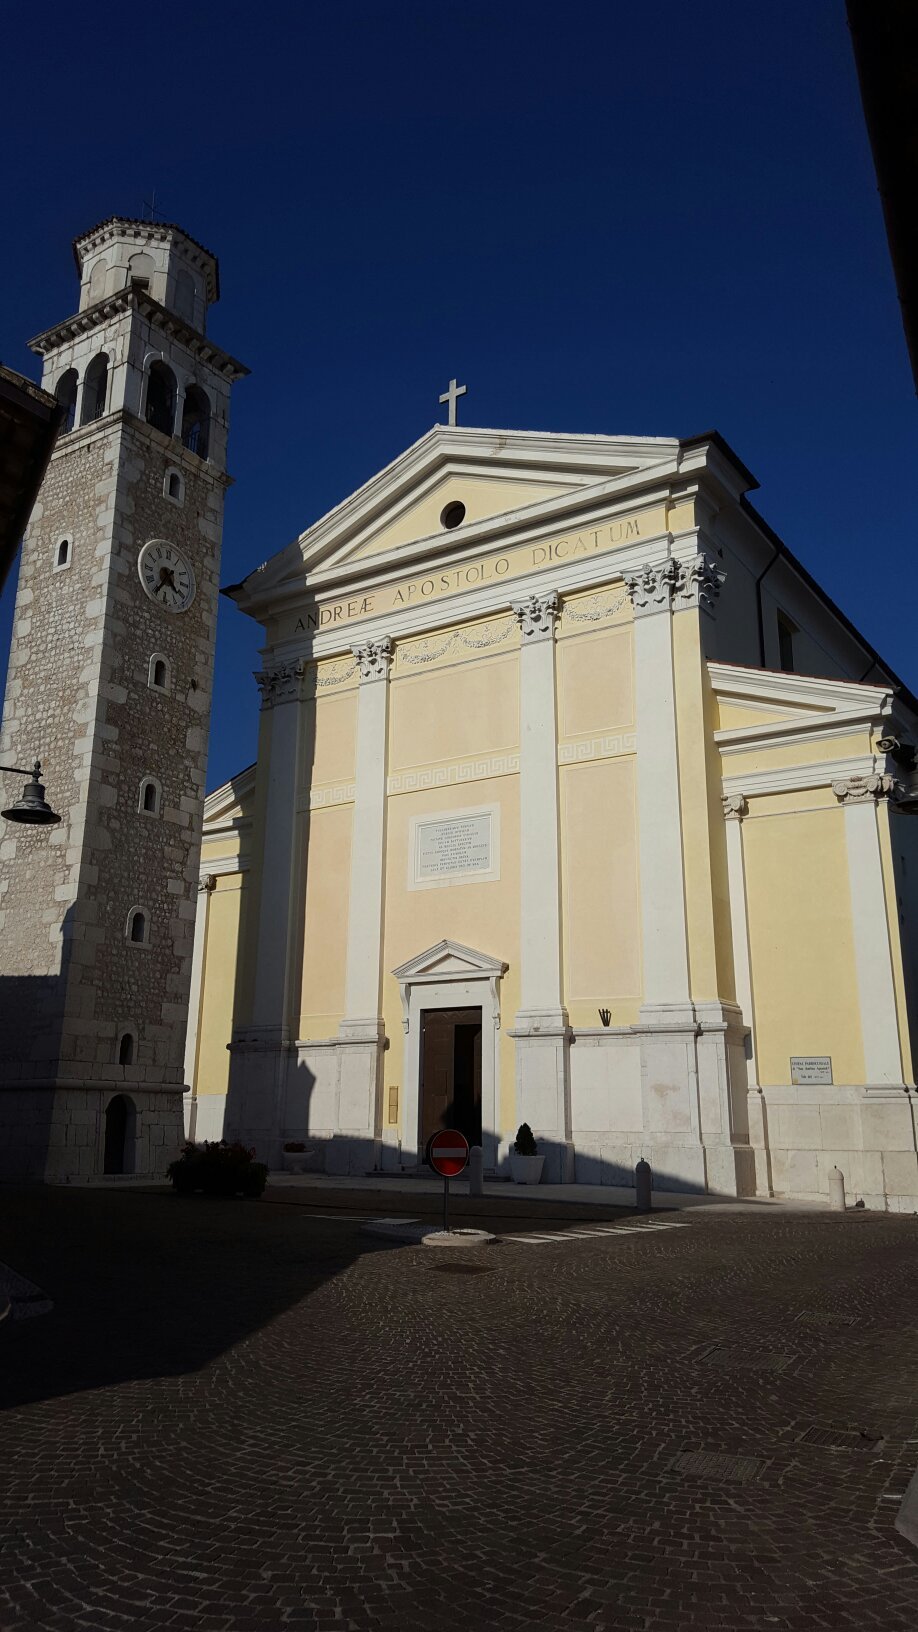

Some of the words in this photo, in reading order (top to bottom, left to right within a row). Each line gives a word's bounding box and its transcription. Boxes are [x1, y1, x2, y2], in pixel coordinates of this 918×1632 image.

[294, 595, 376, 633] ANDREÆ
[392, 558, 511, 605] APOSTOLO
[531, 519, 641, 565] DICATUM
